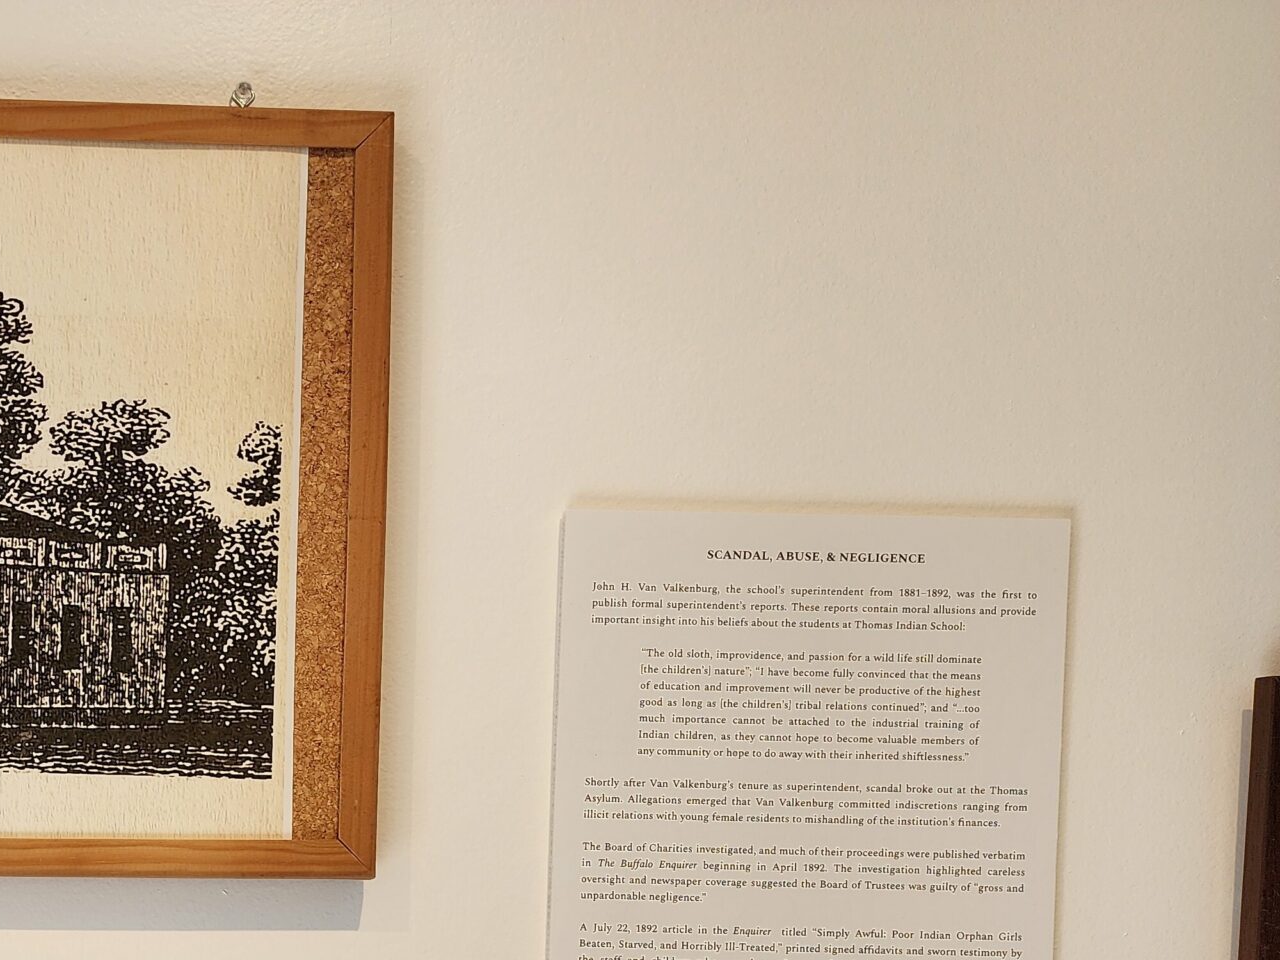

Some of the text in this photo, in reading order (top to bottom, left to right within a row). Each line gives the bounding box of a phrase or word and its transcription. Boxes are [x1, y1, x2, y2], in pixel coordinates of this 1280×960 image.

[706, 549, 925, 563] SCANDAL, ABUSE, & NEGLIGENCE
[592, 580, 615, 592] John
[620, 582, 632, 591] H.
[637, 582, 656, 592] Van
[662, 582, 720, 595] Valkenburg,
[725, 583, 741, 594] the
[790, 585, 864, 598] superintendent
[869, 586, 893, 597] from
[980, 588, 996, 598] the
[1001, 589, 1022, 599] first
[1027, 592, 1037, 600] to
[591, 597, 627, 609] publish
[631, 598, 663, 608] formal
[750, 603, 787, 613] reports.
[790, 601, 820, 612] These
[823, 604, 858, 615] reports
[861, 603, 898, 613] contain
[901, 603, 930, 614] moral
[932, 604, 976, 615] allusions
[978, 605, 997, 615] and
[999, 605, 1037, 618] provide
[591, 614, 965, 631] important insight into his beliefs about the students at Thomas Indian School:
[584, 792, 1027, 814] Asylum. Allegations emerged that Van Valkenburg committed indiscretions ranging from
[581, 857, 1025, 878] in The Buffalo Enquirer beginning in April 1892. The investigation highlighted careless
